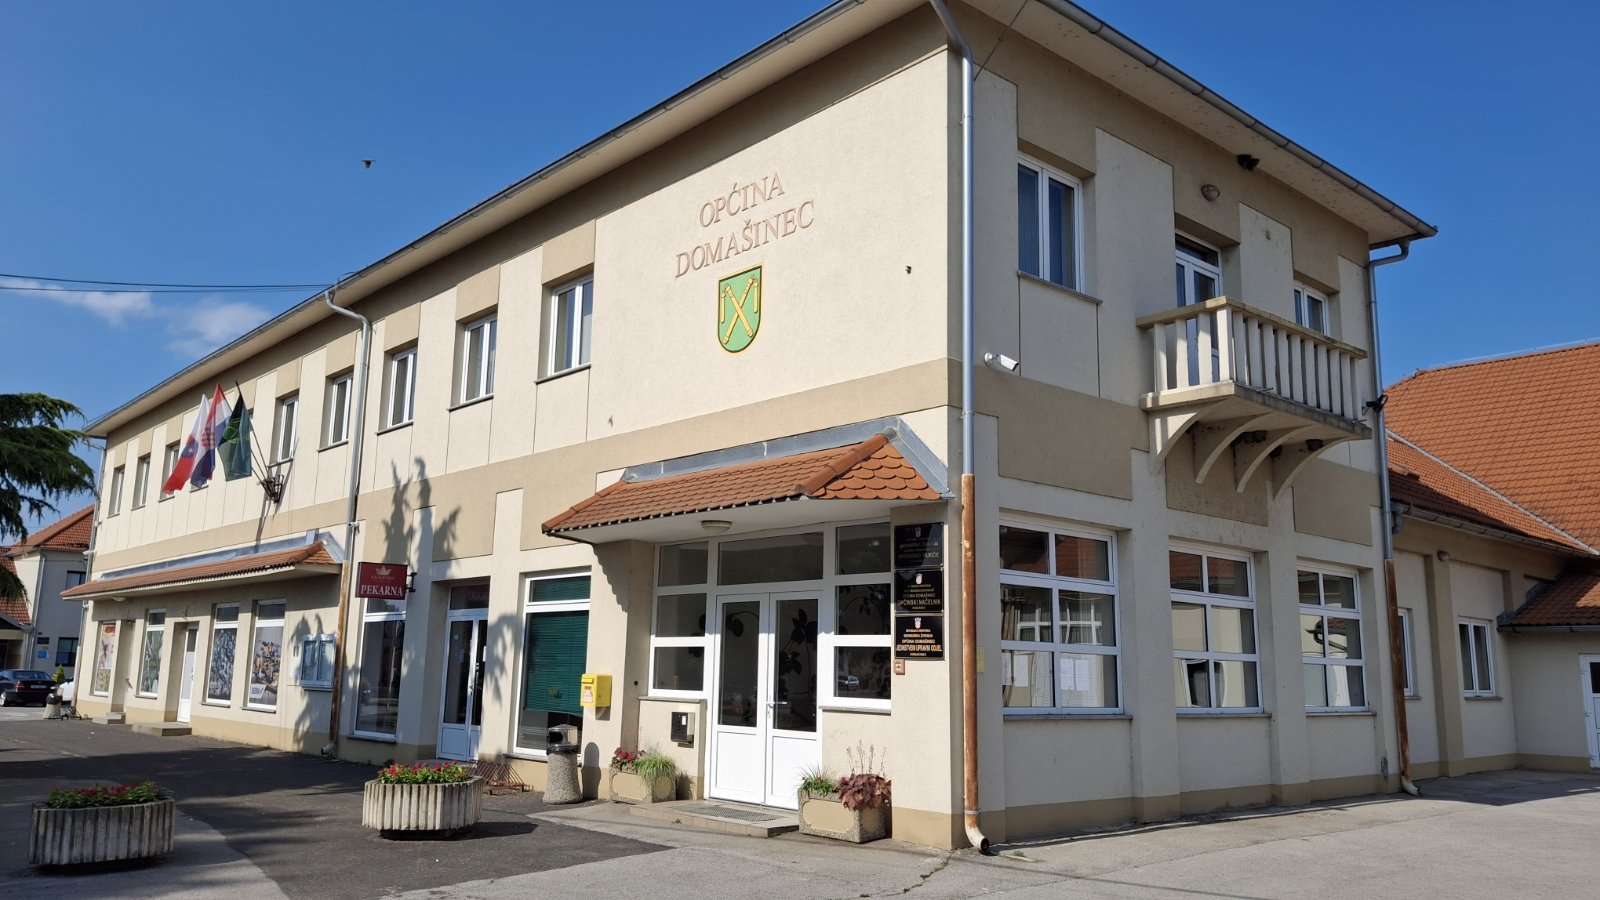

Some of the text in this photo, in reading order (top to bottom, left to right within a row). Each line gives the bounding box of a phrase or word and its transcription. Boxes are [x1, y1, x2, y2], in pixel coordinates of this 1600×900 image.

[699, 172, 786, 228] OPĆINA
[675, 199, 815, 278] DOMAŠINEC
[360, 584, 403, 596] PEKARNA
[918, 597, 941, 605] NAČELNIK
